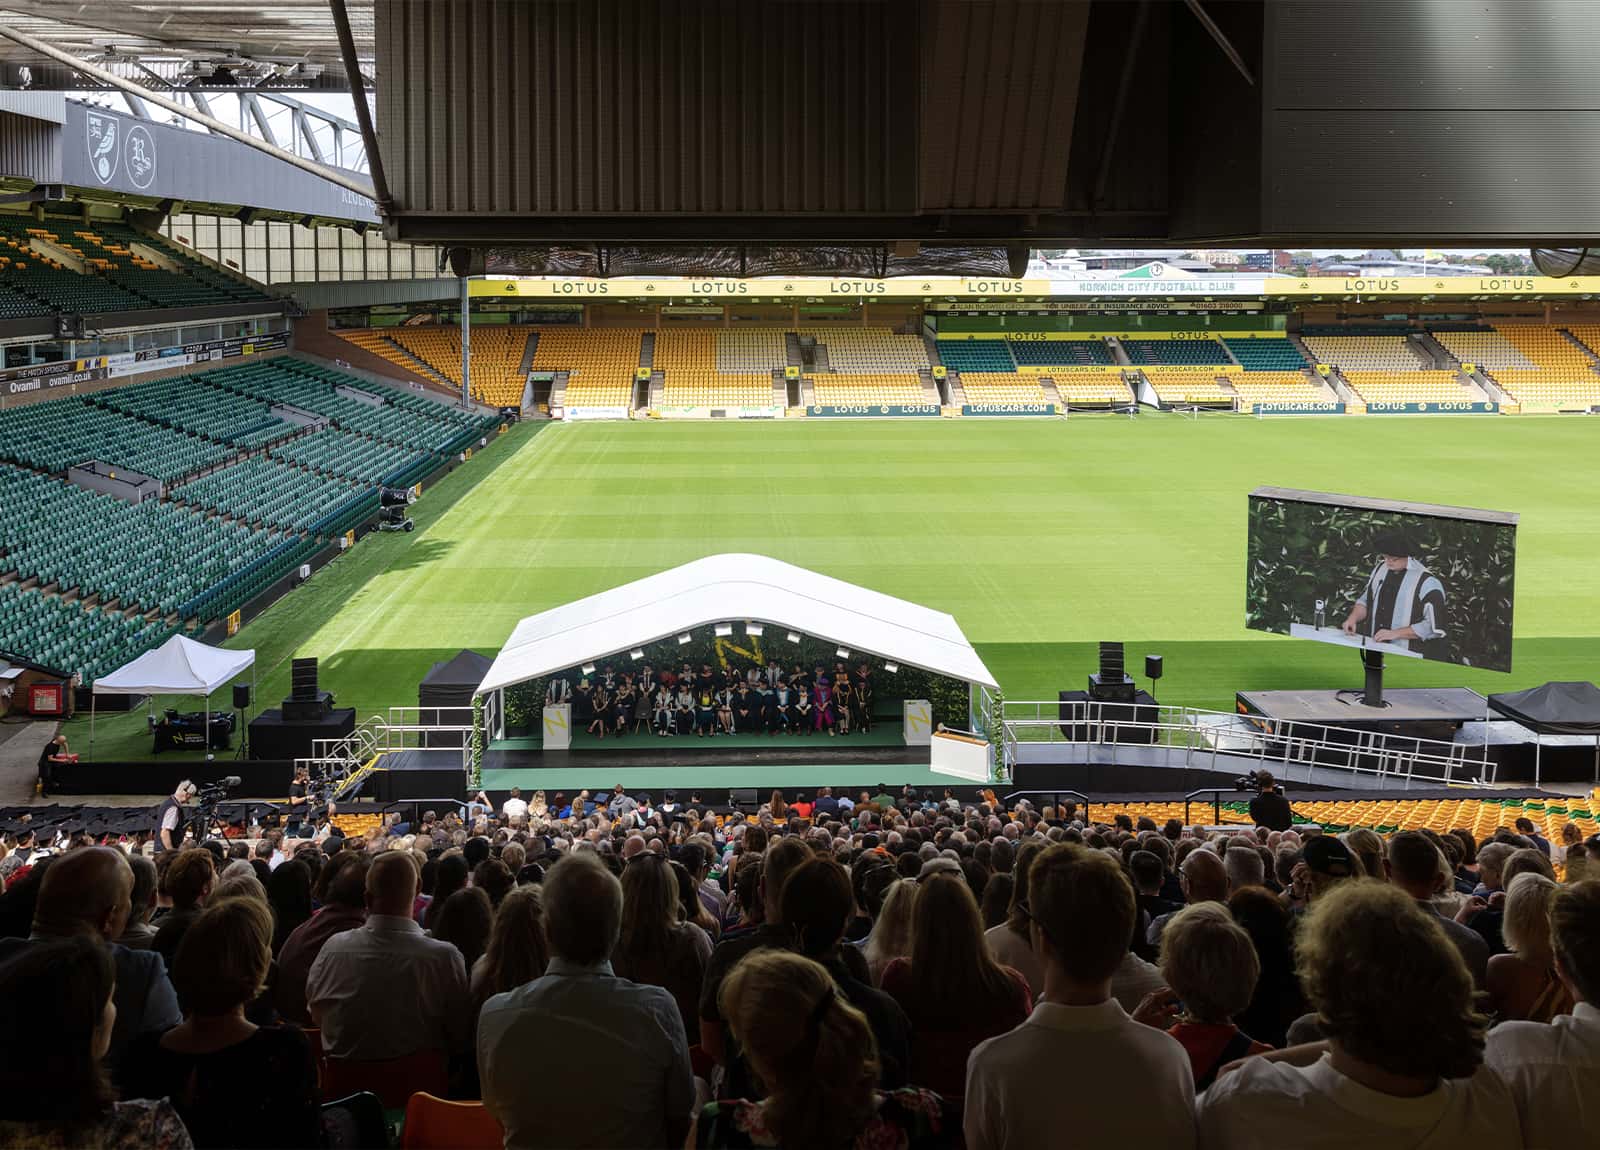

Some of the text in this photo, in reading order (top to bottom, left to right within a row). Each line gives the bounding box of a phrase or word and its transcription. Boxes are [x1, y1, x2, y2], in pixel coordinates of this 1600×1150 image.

[552, 282, 608, 294] LOTUS
[691, 282, 748, 294] LOTUS
[830, 282, 886, 293] LOTUS
[968, 281, 1023, 293] LOTUS
[1079, 282, 1236, 292] NORWICH CITY FOOTBALL CLUB
[1345, 279, 1400, 291] LOTUS
[1479, 279, 1534, 291] LOTUS
[1008, 333, 1047, 341] LOTUS
[1170, 331, 1209, 340] LOTUS
[10, 371, 92, 393] Ovamill ovamill.co.uk
[834, 406, 869, 414] LOTUS
[902, 405, 937, 413] LOTUS
[971, 404, 1047, 412] LOTUSCARS.COM
[1260, 402, 1337, 411] LOTUSCARS.COM
[1371, 402, 1406, 410] LOTUS
